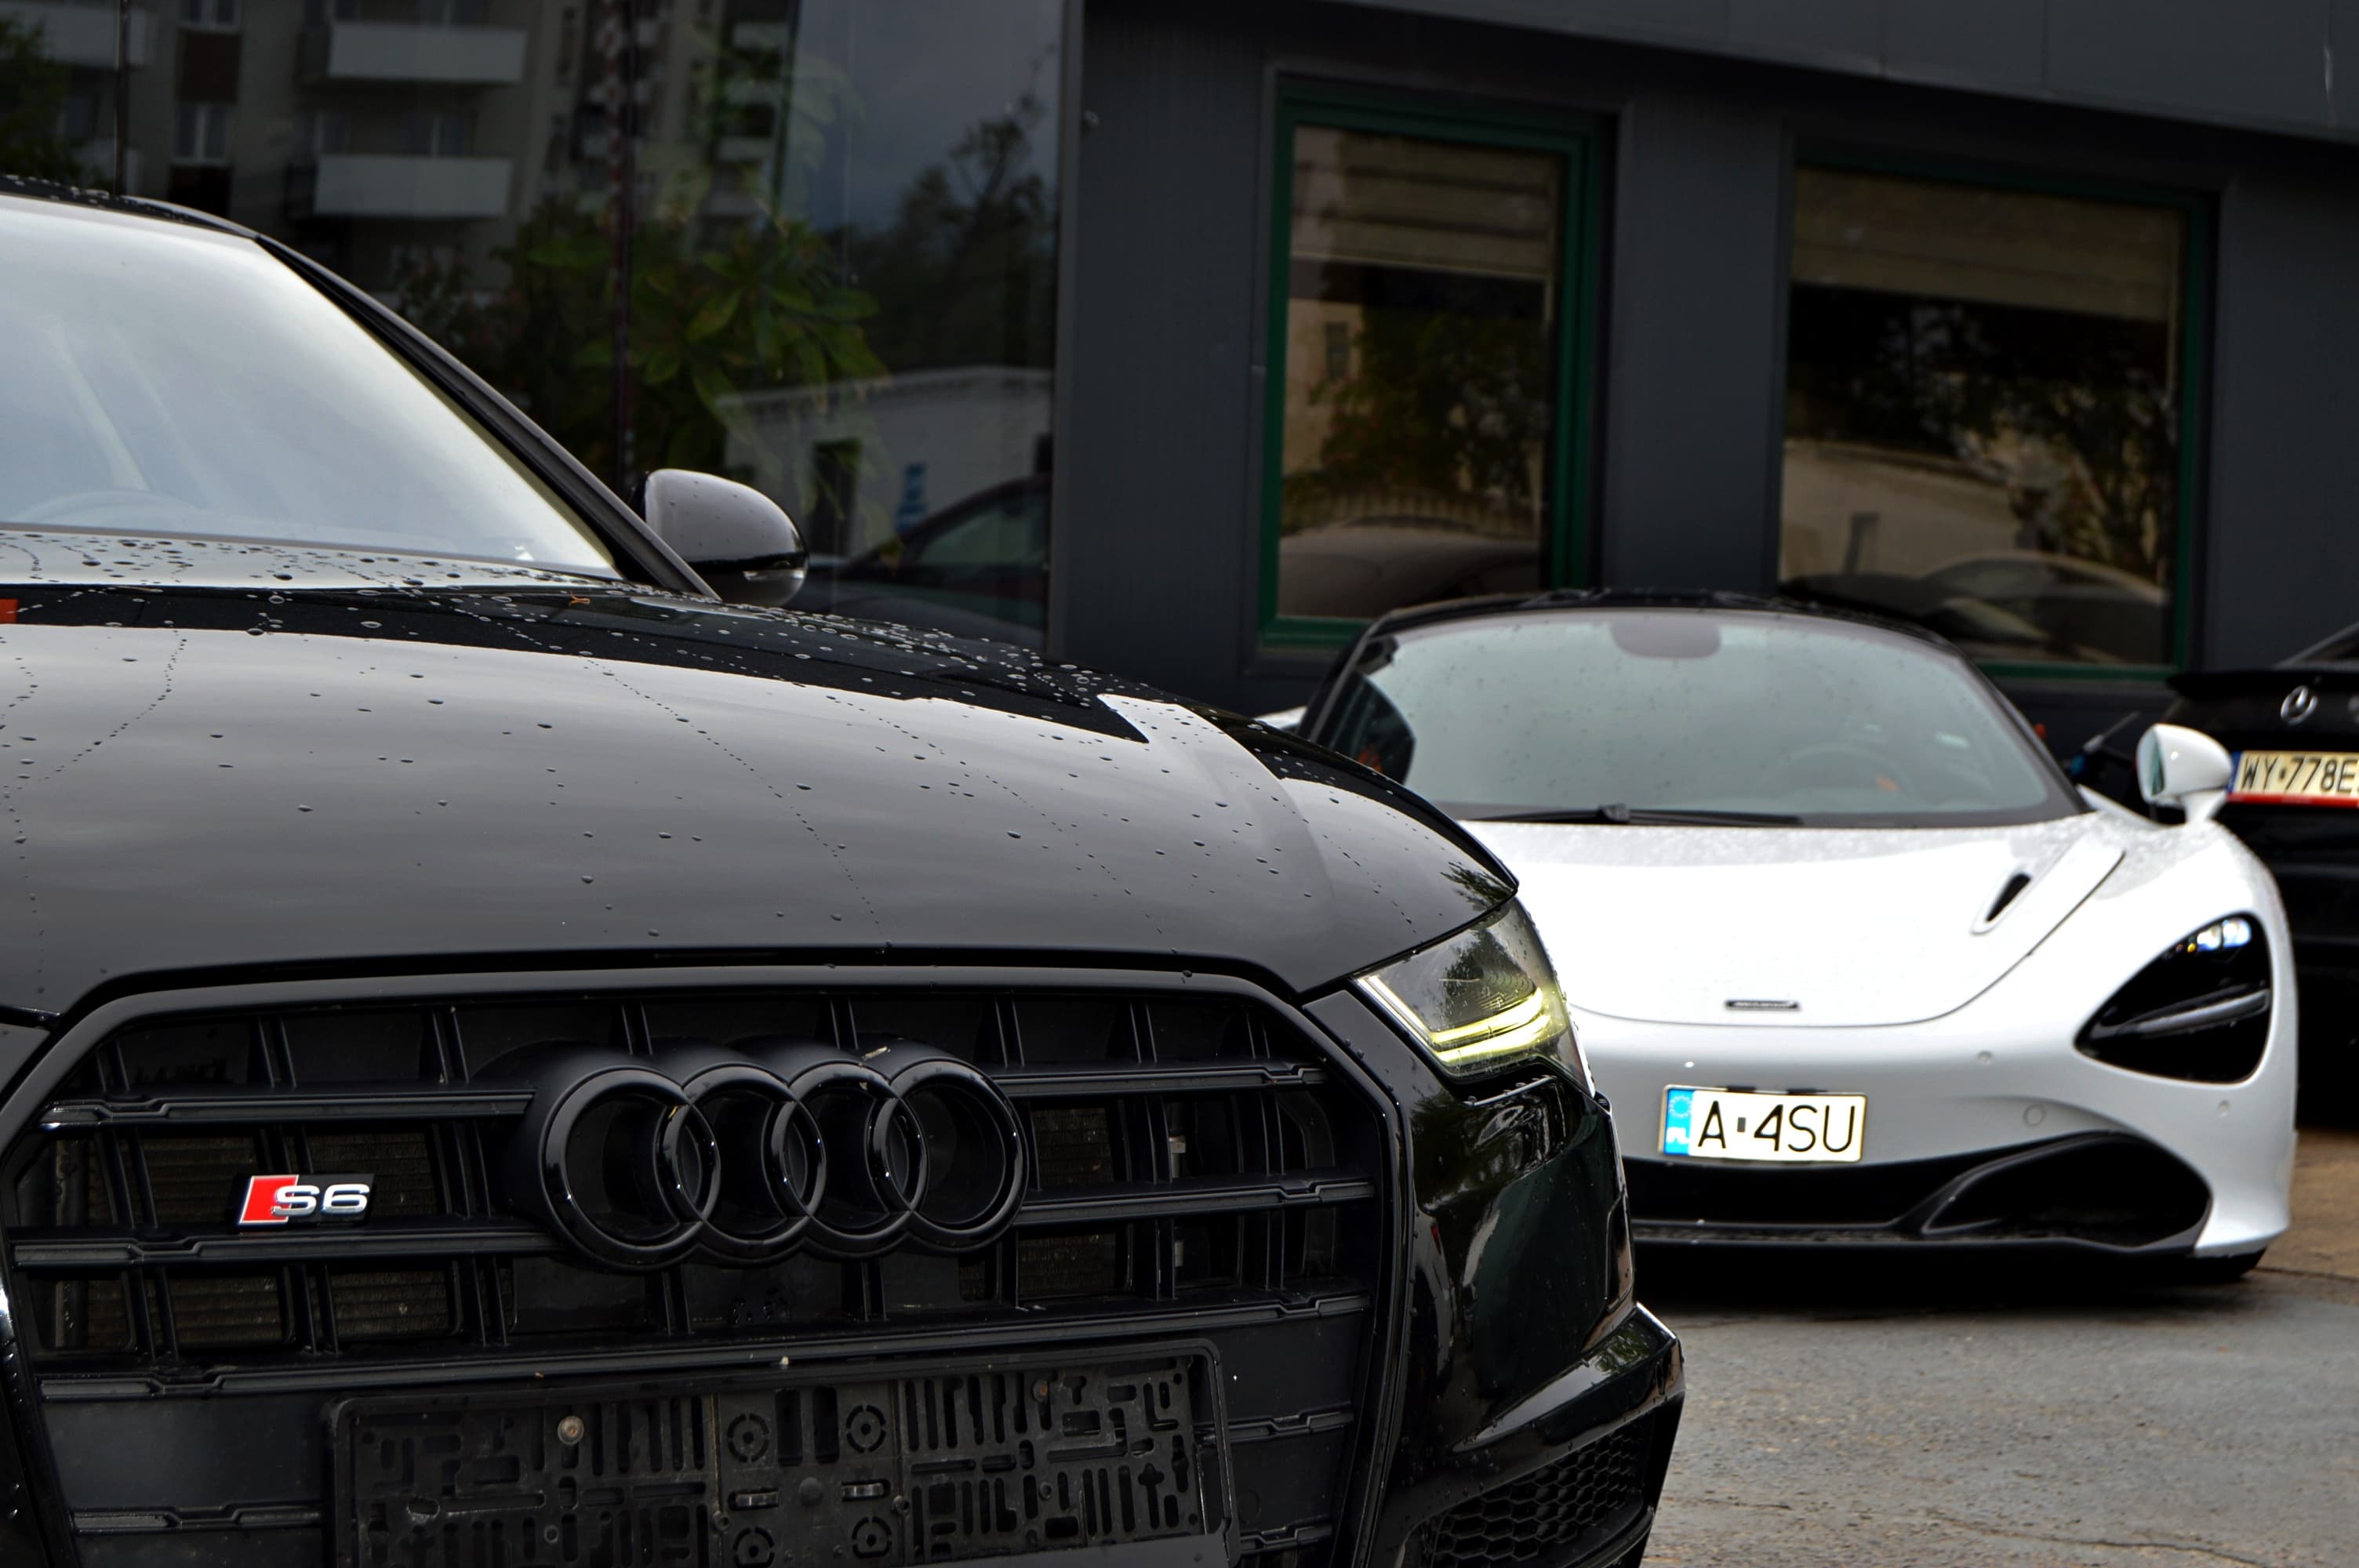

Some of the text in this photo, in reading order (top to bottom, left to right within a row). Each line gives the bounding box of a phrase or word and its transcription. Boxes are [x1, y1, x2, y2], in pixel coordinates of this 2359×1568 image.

[2241, 756, 2359, 793] WY 778E
[1698, 1101, 1856, 1152] A 4SU
[271, 1184, 370, 1215] S6
